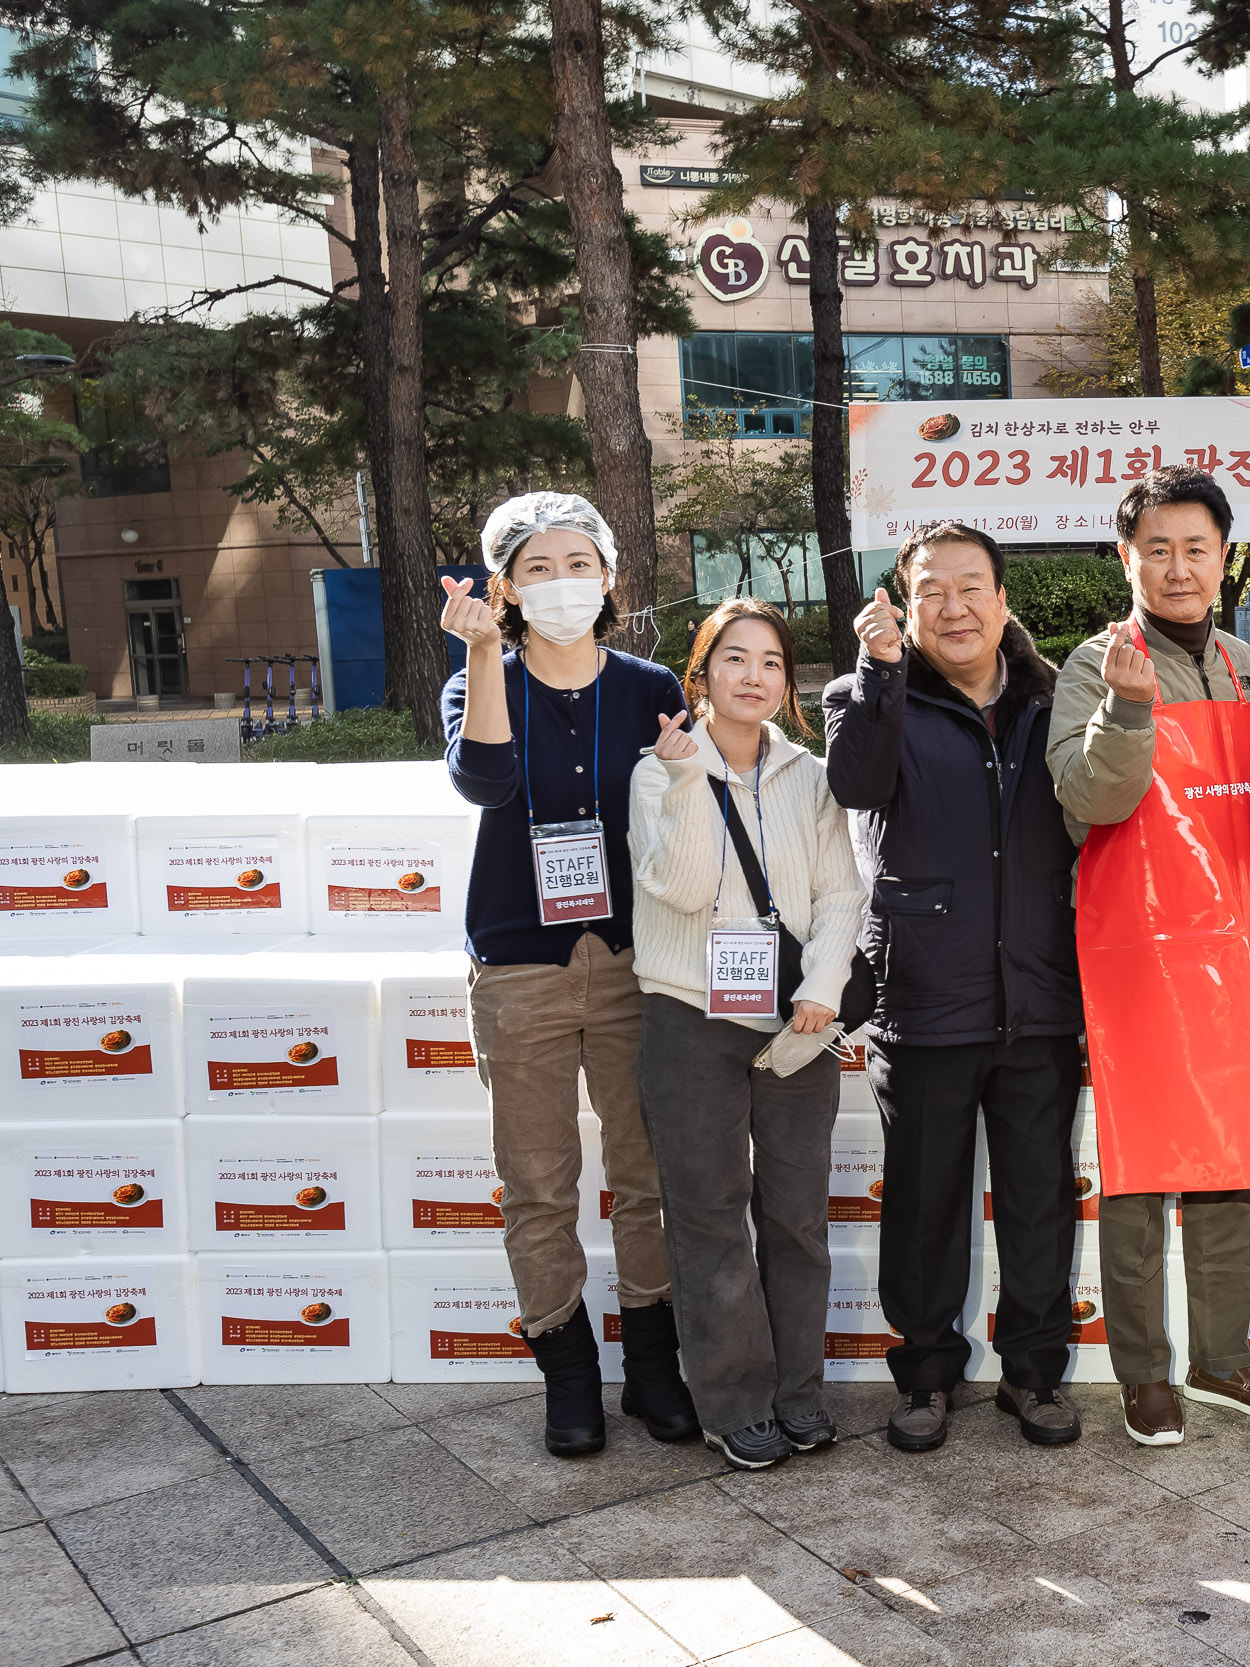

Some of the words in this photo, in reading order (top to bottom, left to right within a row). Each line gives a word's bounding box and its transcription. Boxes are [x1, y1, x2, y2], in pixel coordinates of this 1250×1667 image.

[961, 355, 987, 370] 문의
[962, 371, 1001, 386] 4650
[970, 421, 998, 437] 김치
[1004, 420, 1069, 436] 한상자로
[1074, 420, 1123, 436] 전하는
[1128, 419, 1161, 435] 안부
[911, 449, 1031, 489] 2023
[1046, 444, 1162, 489] 제1회
[996, 515, 1038, 531] 20(월)
[1184, 786, 1203, 799] 광진
[1205, 783, 1229, 797] 사랑의
[546, 856, 595, 874] STAFF
[545, 871, 600, 889] 진행요원
[719, 951, 769, 965] STAFF
[716, 967, 769, 981] 진행요원
[39, 1018, 61, 1026] 제1회
[63, 1017, 79, 1026] 광진
[82, 1016, 106, 1025] 사랑의
[108, 1015, 141, 1024] 김장축제
[229, 1030, 249, 1038] 제1회
[251, 1029, 267, 1038] 광진
[270, 1028, 293, 1037] 사랑의
[296, 1027, 328, 1036] 김장축제
[53, 1169, 74, 1177] 제1회
[77, 1169, 93, 1178] 광진
[95, 1169, 119, 1178] 사랑의
[123, 1169, 155, 1178] 김장축제
[238, 1172, 258, 1180] 제1회
[260, 1172, 276, 1181] 광진
[278, 1172, 302, 1181] 사랑의
[306, 1172, 337, 1181] 김장축제
[46, 1291, 66, 1299] 제1회
[69, 1290, 85, 1299] 광진
[87, 1289, 111, 1298] 사랑의
[114, 1288, 146, 1297] 김장축제
[244, 1288, 264, 1296] 제1회
[266, 1288, 282, 1296] 광진
[284, 1288, 308, 1297] 사랑의
[311, 1289, 342, 1297] 김장축제
